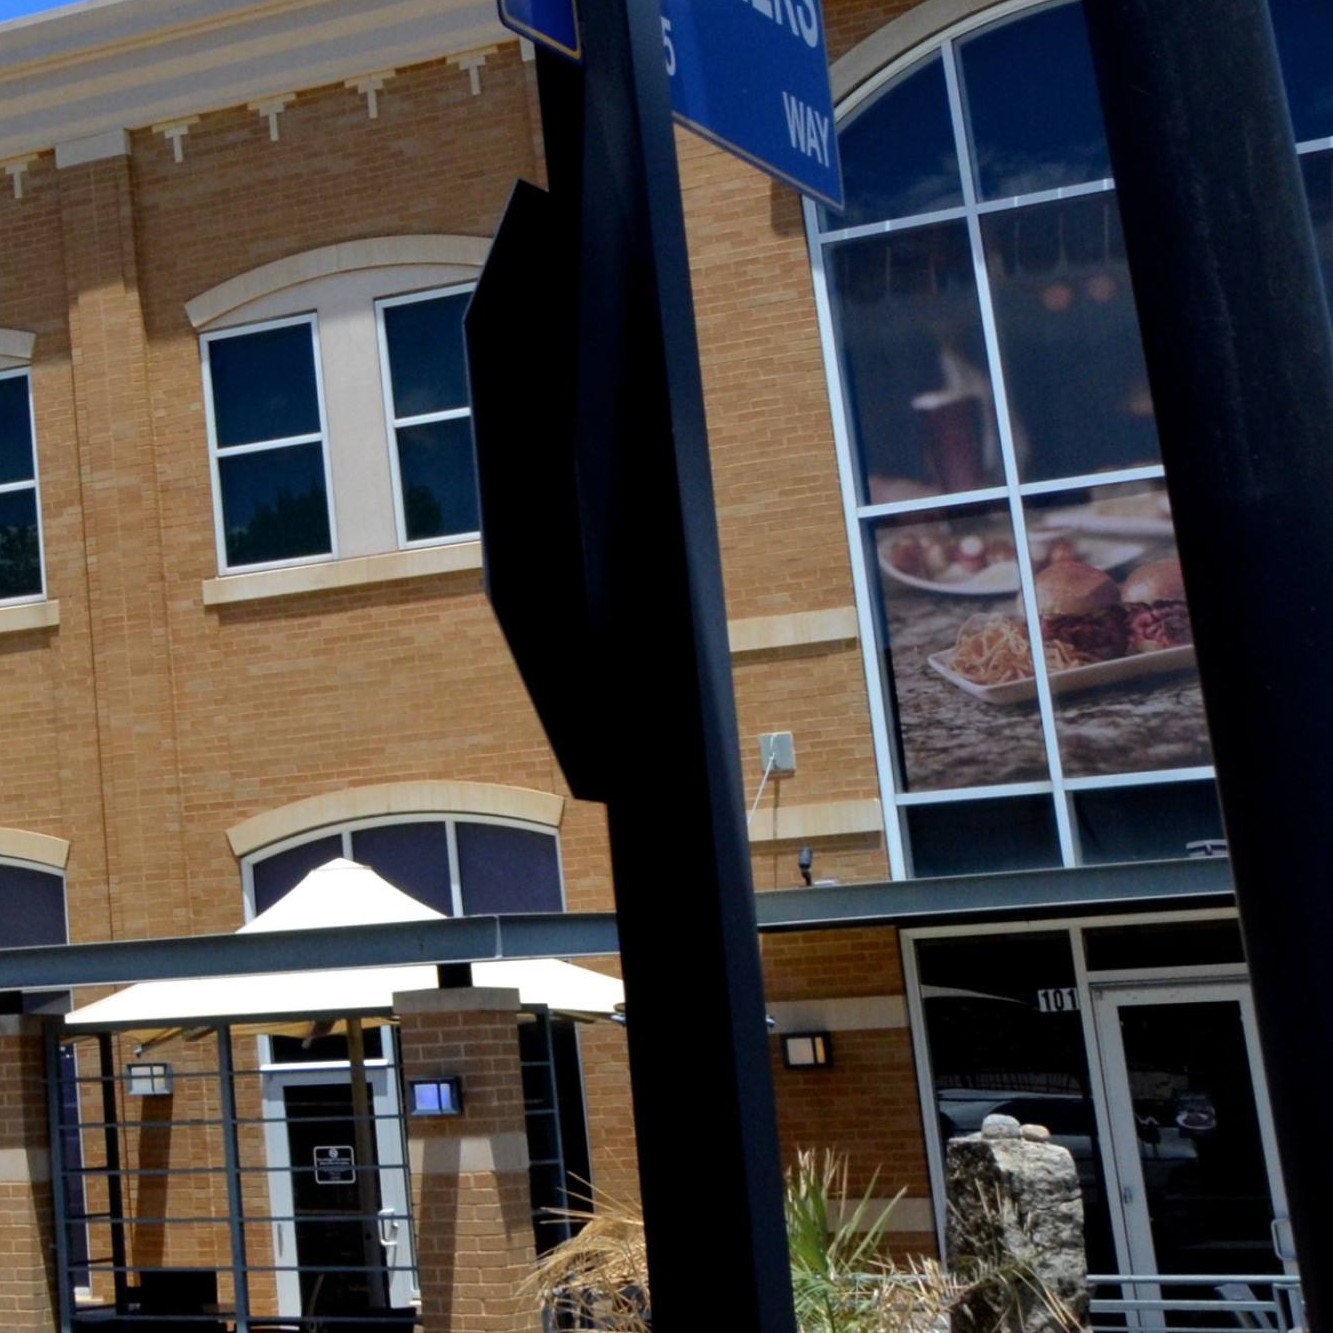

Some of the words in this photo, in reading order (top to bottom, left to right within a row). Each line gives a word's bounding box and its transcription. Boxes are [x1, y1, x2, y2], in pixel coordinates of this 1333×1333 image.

[661, 17, 676, 77] 5
[782, 91, 830, 168] WAY
[1042, 988, 1076, 1011] 101
